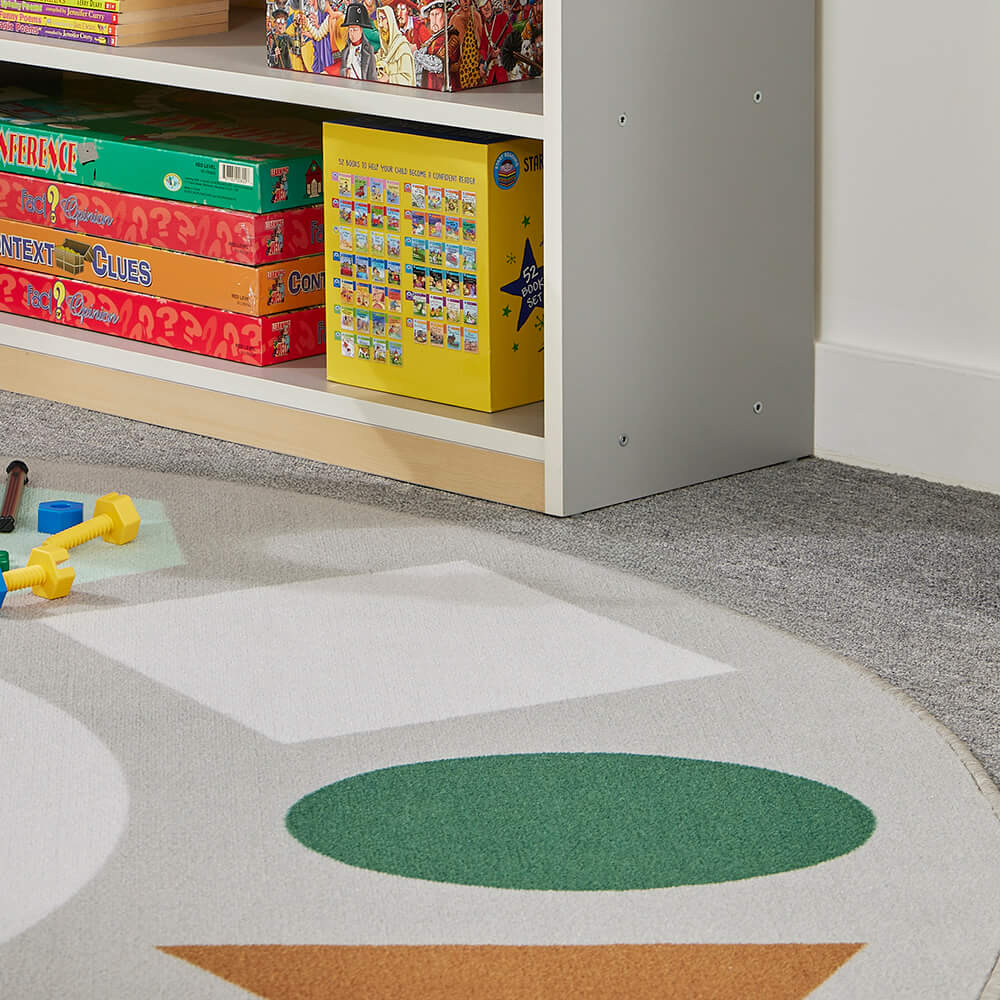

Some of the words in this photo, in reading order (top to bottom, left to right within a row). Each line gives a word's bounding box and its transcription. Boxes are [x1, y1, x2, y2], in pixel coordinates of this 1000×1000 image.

[91, 244, 152, 287] CLUES
[522, 264, 538, 284] 52
[521, 277, 544, 297] BOOK
[27, 284, 52, 315] Fact
[66, 291, 120, 324] Opinion
[526, 292, 543, 308] SET
